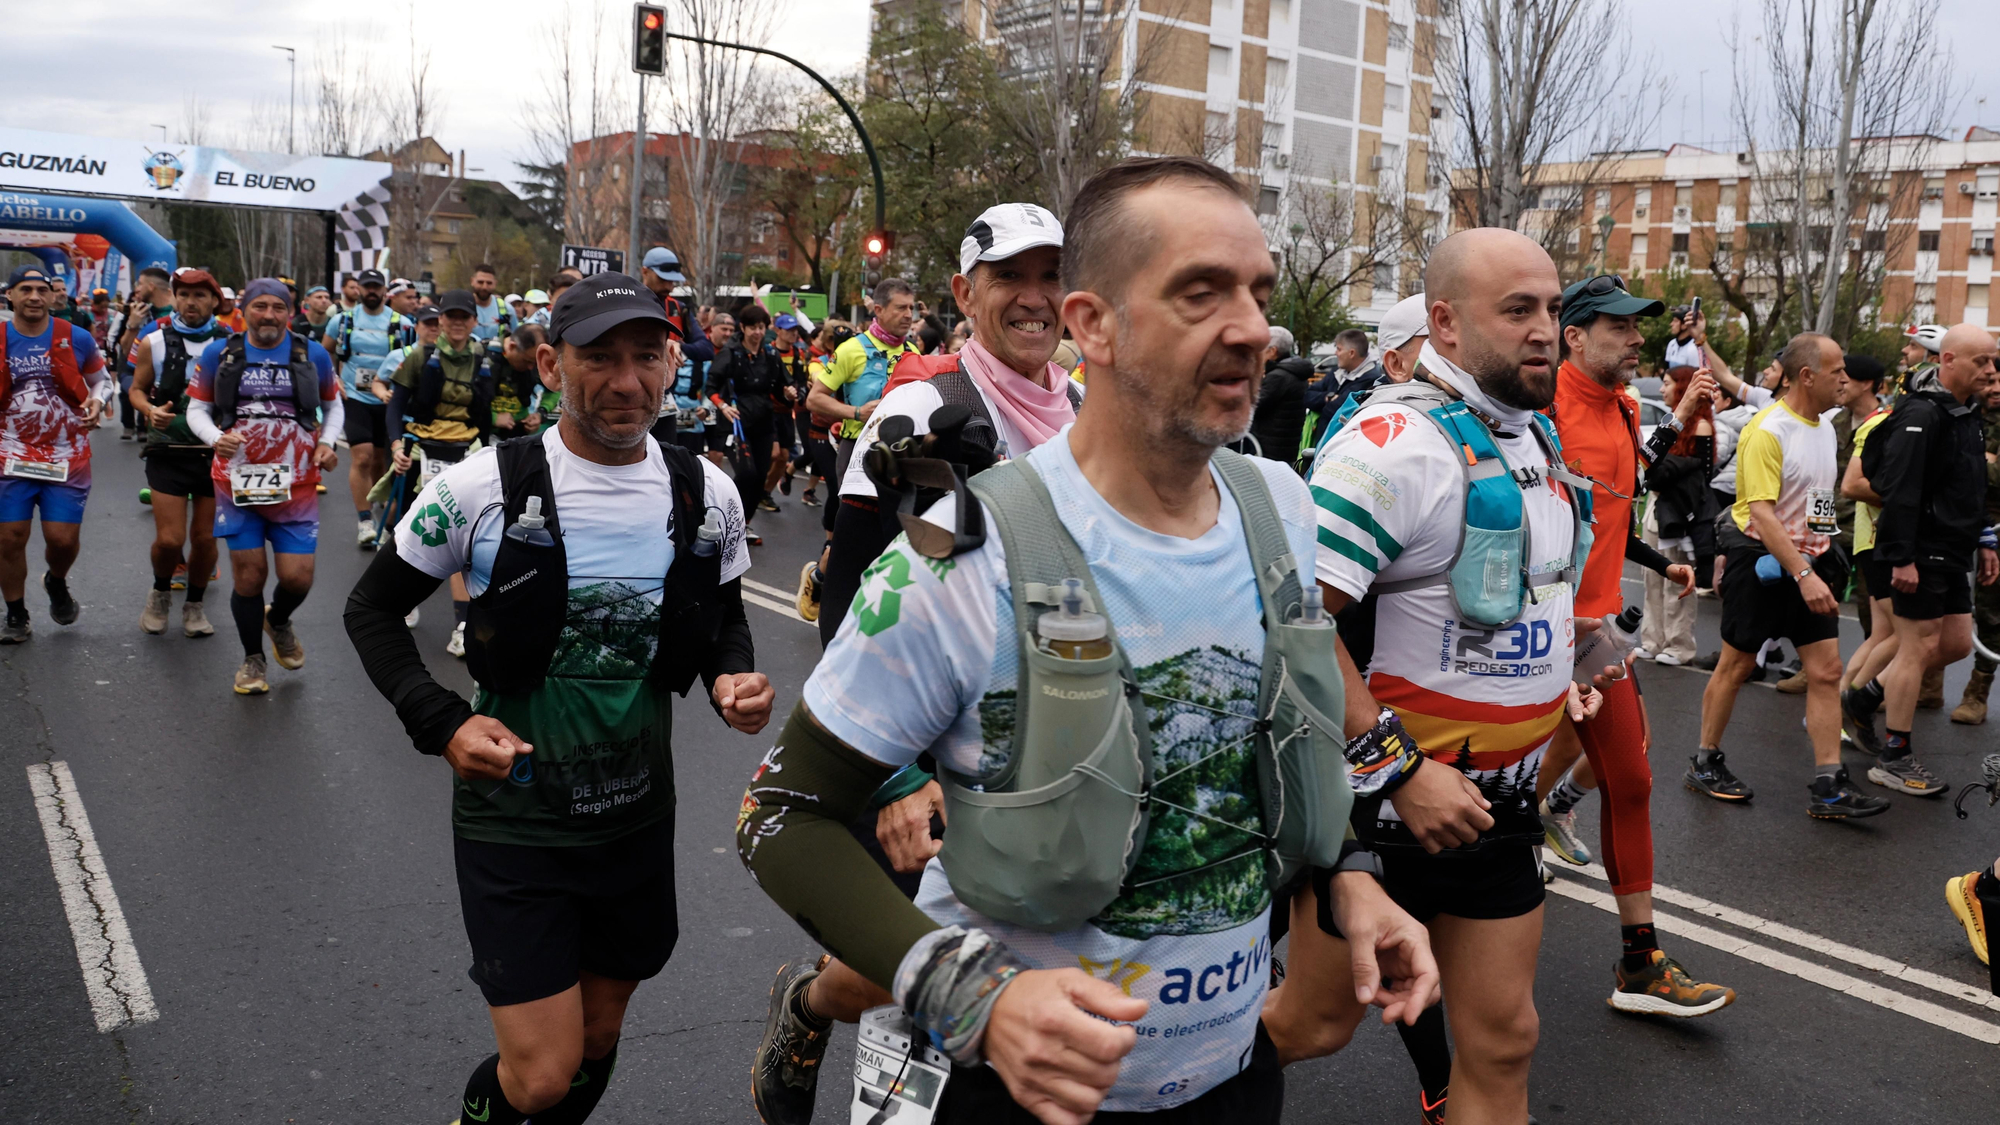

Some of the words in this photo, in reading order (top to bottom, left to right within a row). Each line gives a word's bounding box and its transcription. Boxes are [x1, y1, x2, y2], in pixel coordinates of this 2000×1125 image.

[0, 151, 107, 176] GUZMÁN
[214, 171, 239, 187] EL
[243, 173, 316, 193] BUENO
[596, 287, 636, 299] KIPRUN
[241, 473, 281, 488] 774
[434, 478, 468, 529] AGUILAR
[498, 568, 538, 593] SALOMON
[1042, 684, 1109, 700] SALOMON
[573, 726, 651, 758] INSPECCIOES
[572, 786, 592, 800] DE
[596, 764, 650, 796] TUBERAS
[570, 798, 612, 816] (Sergio
[613, 779, 652, 806] Mezcua)
